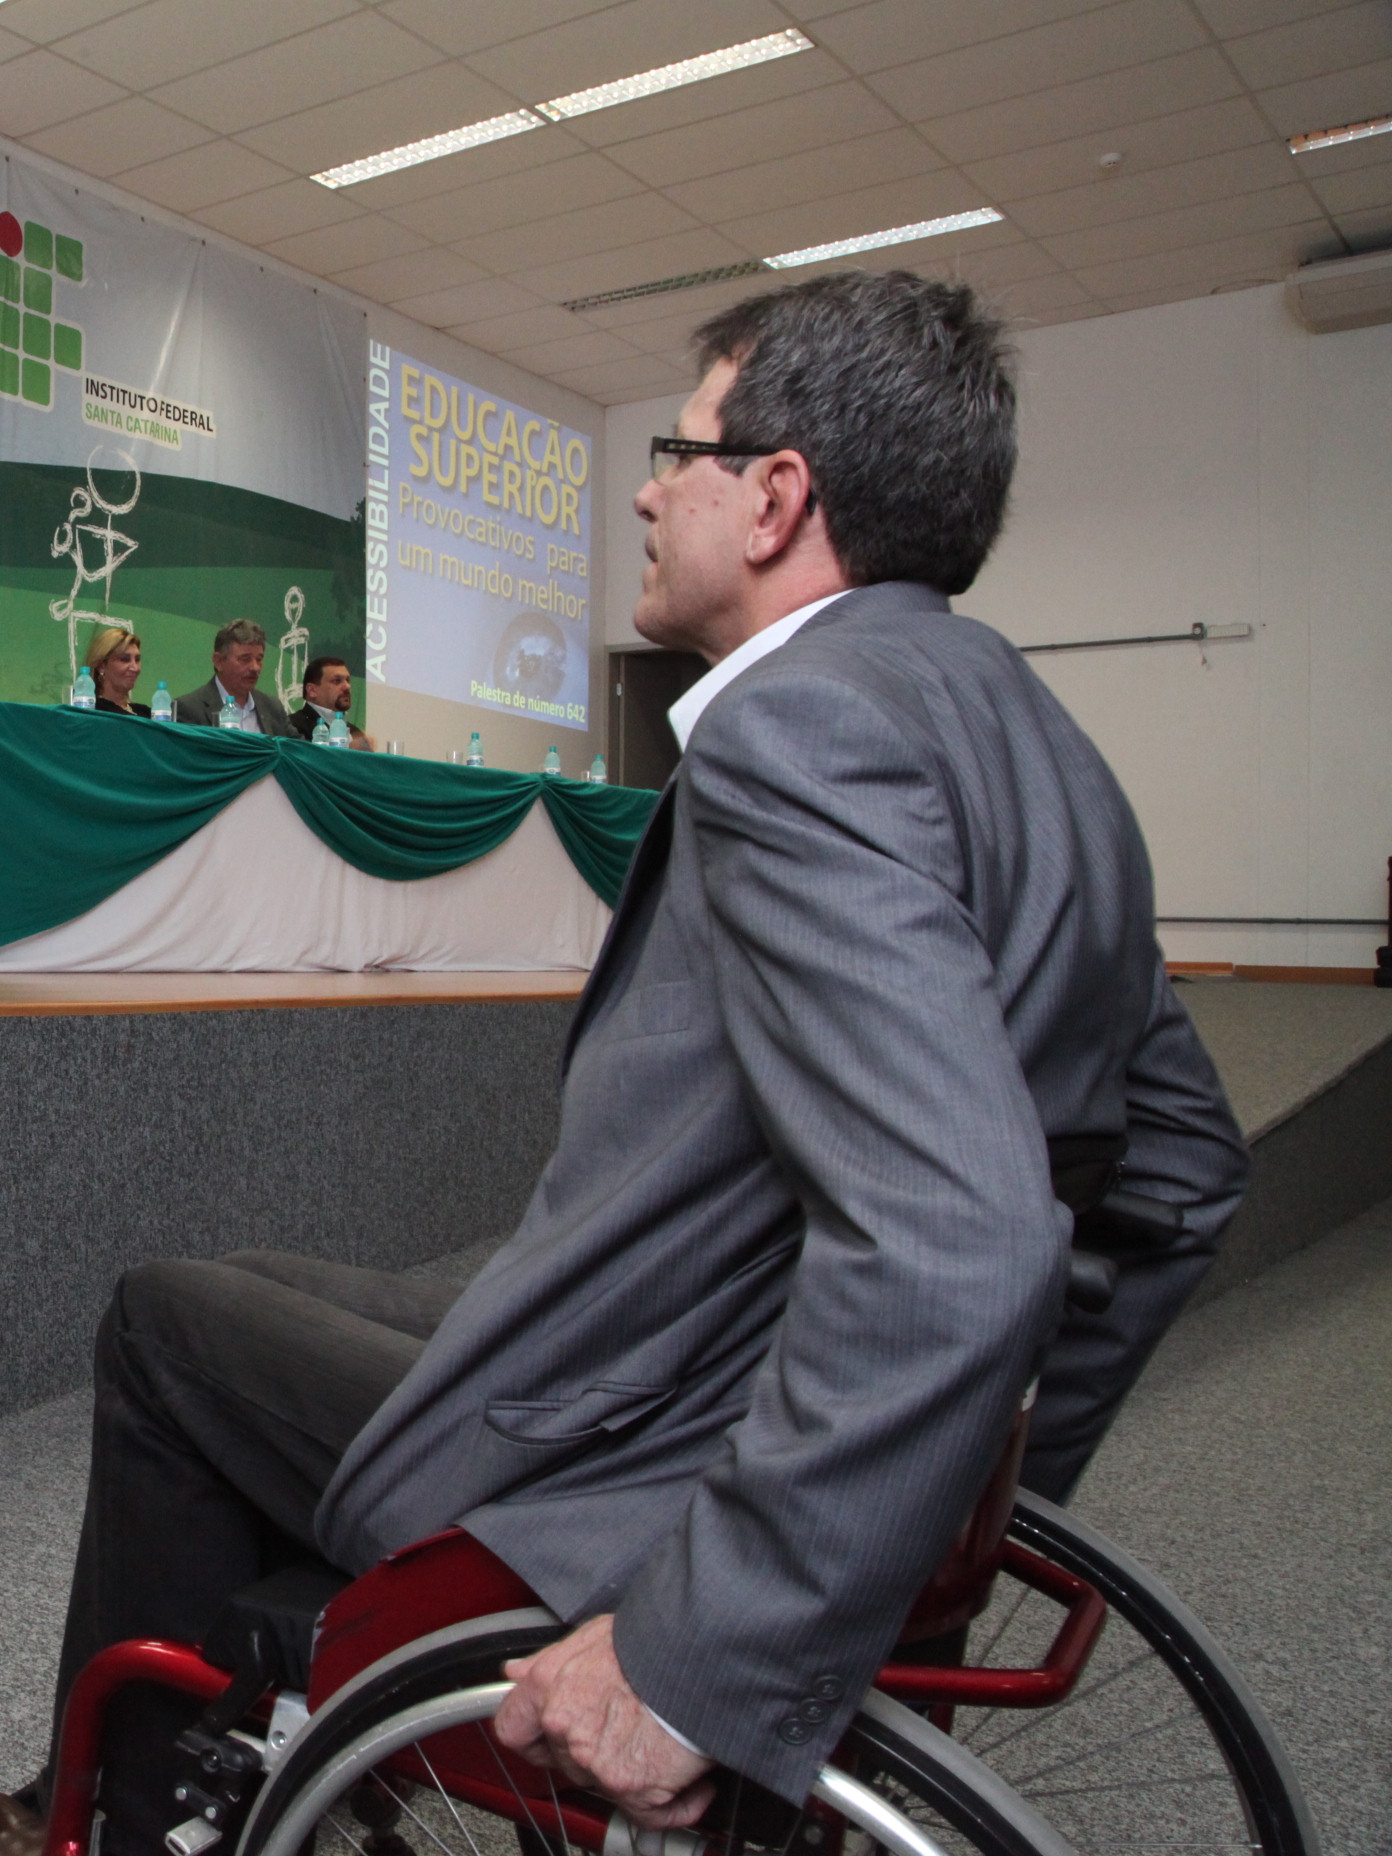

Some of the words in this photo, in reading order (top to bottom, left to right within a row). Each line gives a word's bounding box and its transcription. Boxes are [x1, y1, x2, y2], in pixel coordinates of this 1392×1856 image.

[85, 377, 158, 413] INSTITUTO
[160, 400, 213, 432] FEDERAL
[85, 402, 123, 429] SANTA
[126, 415, 179, 445] CATARINA
[401, 364, 588, 488] EDUCAÇÃO
[366, 338, 391, 683] ACESSIBILIDADE
[409, 423, 581, 535] SUPERIOR
[399, 482, 535, 559] Provocativos
[547, 543, 588, 577] para
[398, 540, 433, 574] um
[439, 552, 513, 599] mundo
[518, 578, 586, 620] melhor
[470, 680, 511, 705] Palestra
[513, 690, 526, 709] de
[528, 695, 565, 718] número
[567, 702, 585, 722] 642
